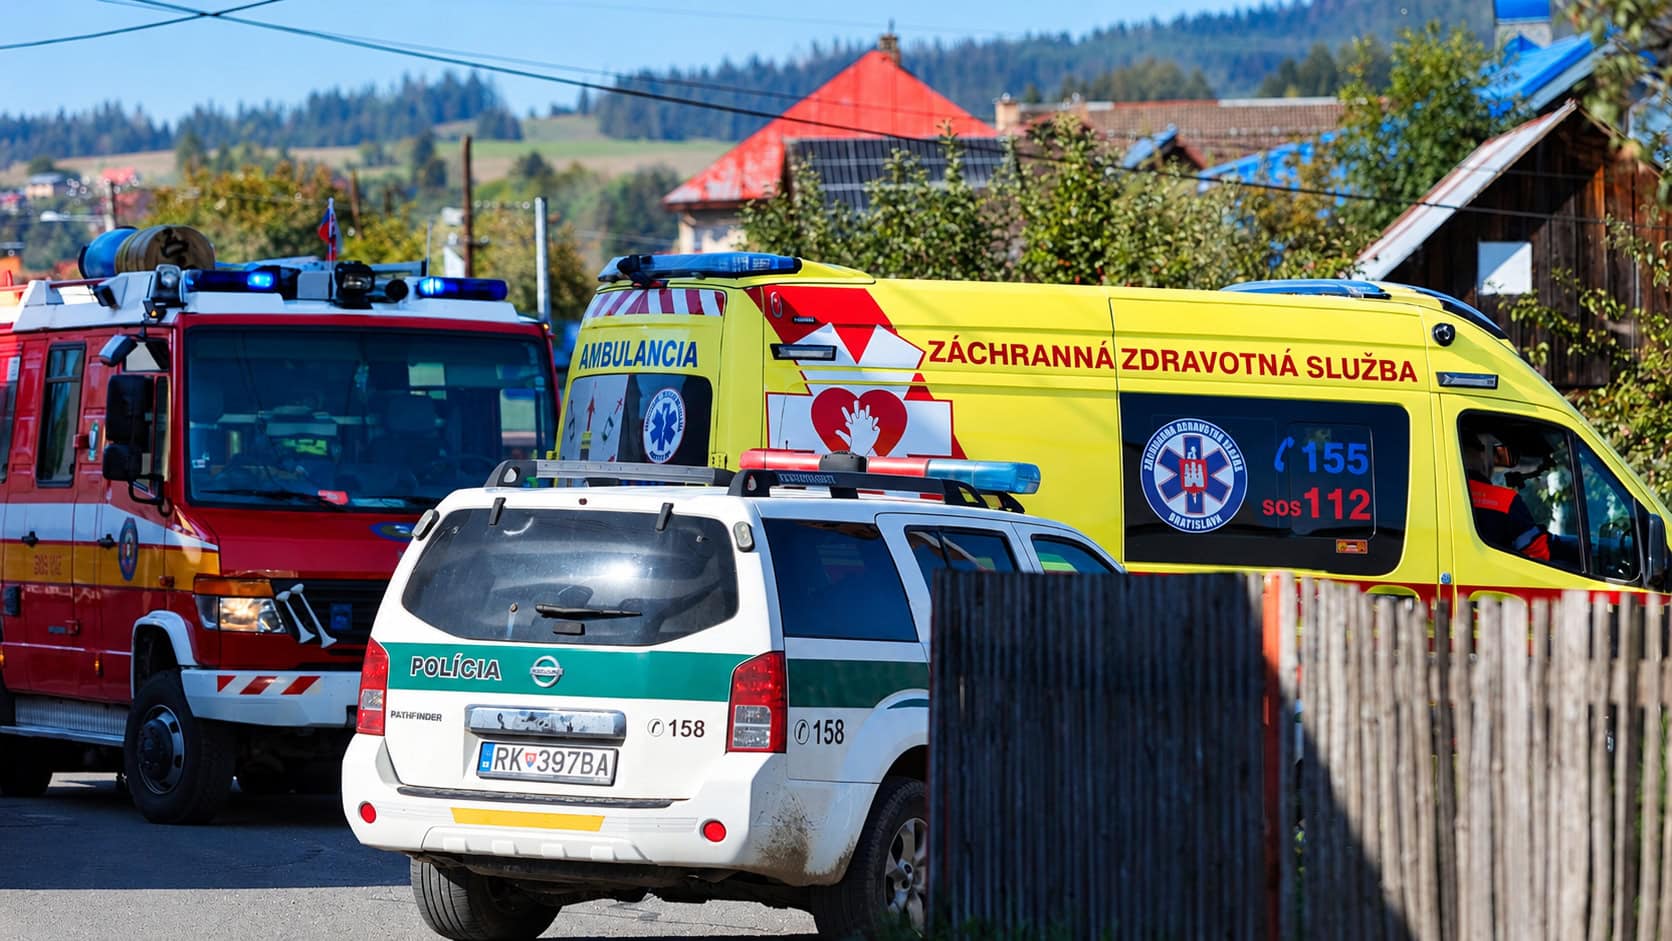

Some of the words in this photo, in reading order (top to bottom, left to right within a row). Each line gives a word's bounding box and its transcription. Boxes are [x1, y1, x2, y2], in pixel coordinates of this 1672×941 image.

[579, 340, 698, 370] AMBULANCIA
[928, 335, 1115, 369] ZÁCHRANNÁ
[1121, 348, 1299, 377] ZDRAVOTNÁ
[1306, 352, 1418, 382] SLUŽBA
[1302, 441, 1369, 475] 155
[1303, 487, 1371, 520] 112
[410, 653, 502, 681] POLÍCIA
[390, 710, 442, 722] PATHFINDER
[668, 719, 705, 738] 158
[813, 719, 845, 745] 158
